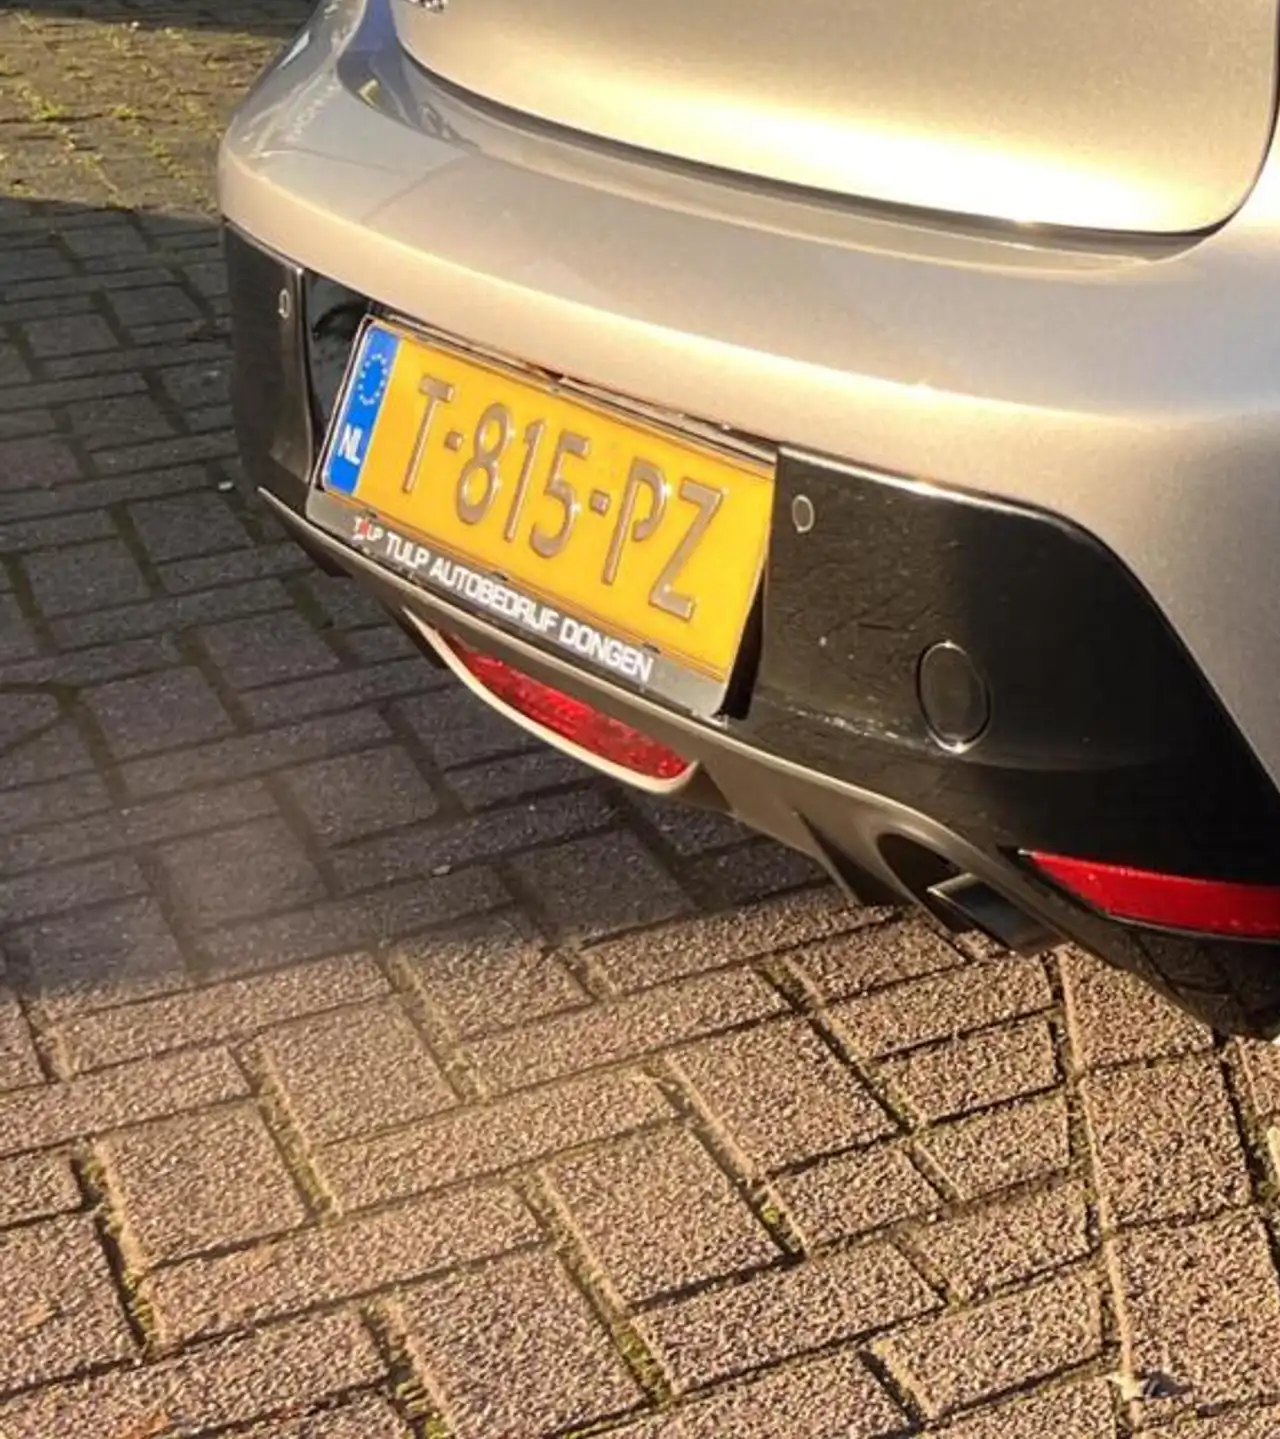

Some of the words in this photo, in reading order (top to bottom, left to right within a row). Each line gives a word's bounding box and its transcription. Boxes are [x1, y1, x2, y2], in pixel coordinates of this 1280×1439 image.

[337, 424, 361, 465] NL
[402, 373, 728, 622] T-815-PZ
[386, 531, 430, 569] TULP
[431, 557, 559, 632] AUTOBEDRIJF
[558, 616, 654, 682] DONGEN
